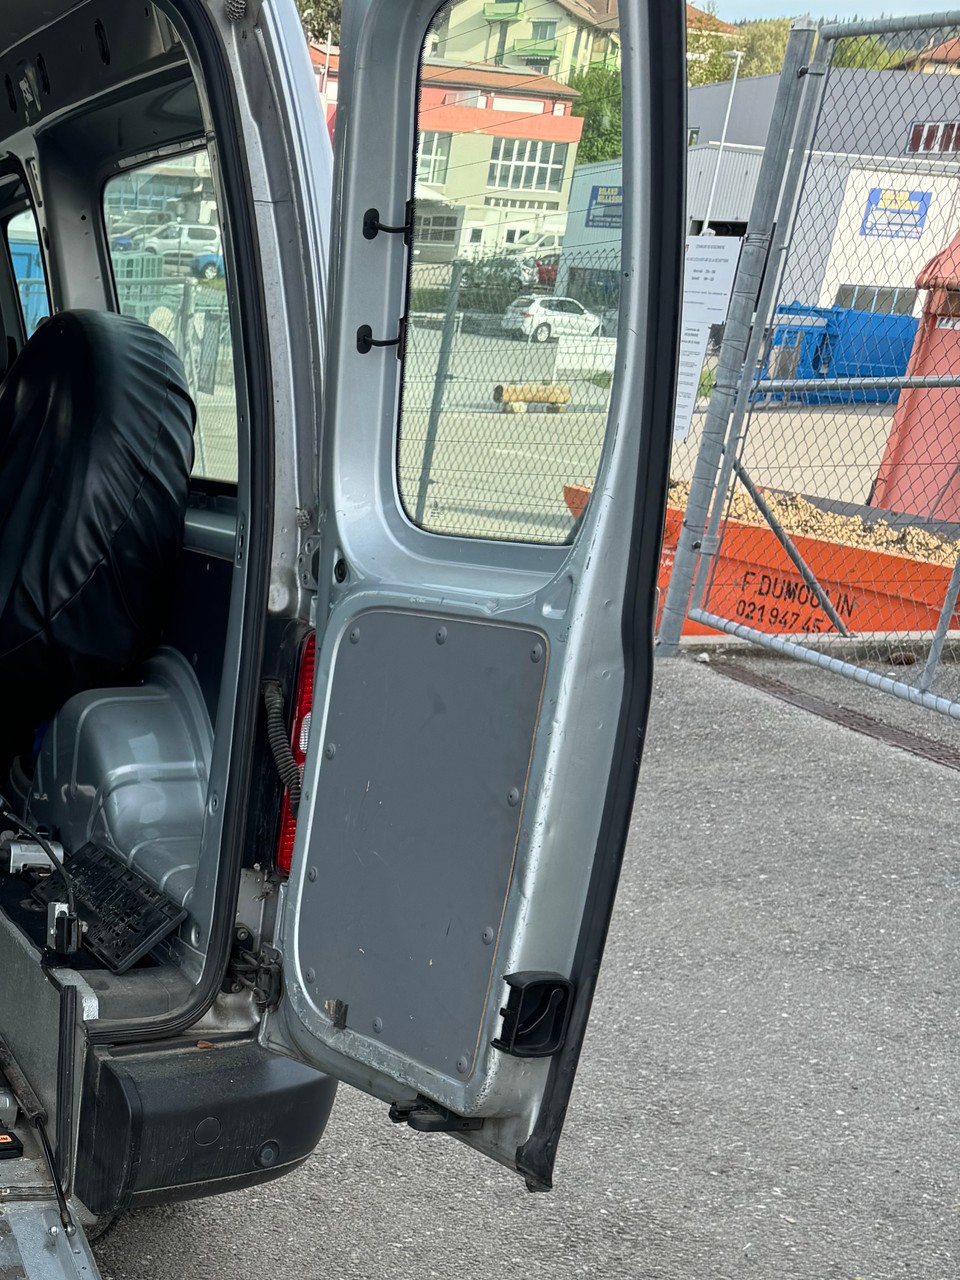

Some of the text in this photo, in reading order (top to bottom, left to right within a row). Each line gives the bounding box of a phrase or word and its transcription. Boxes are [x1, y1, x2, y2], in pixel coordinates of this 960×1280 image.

[741, 571, 855, 617] F.DUMOUIN
[736, 599, 766, 623] 021
[768, 608, 800, 630] 947
